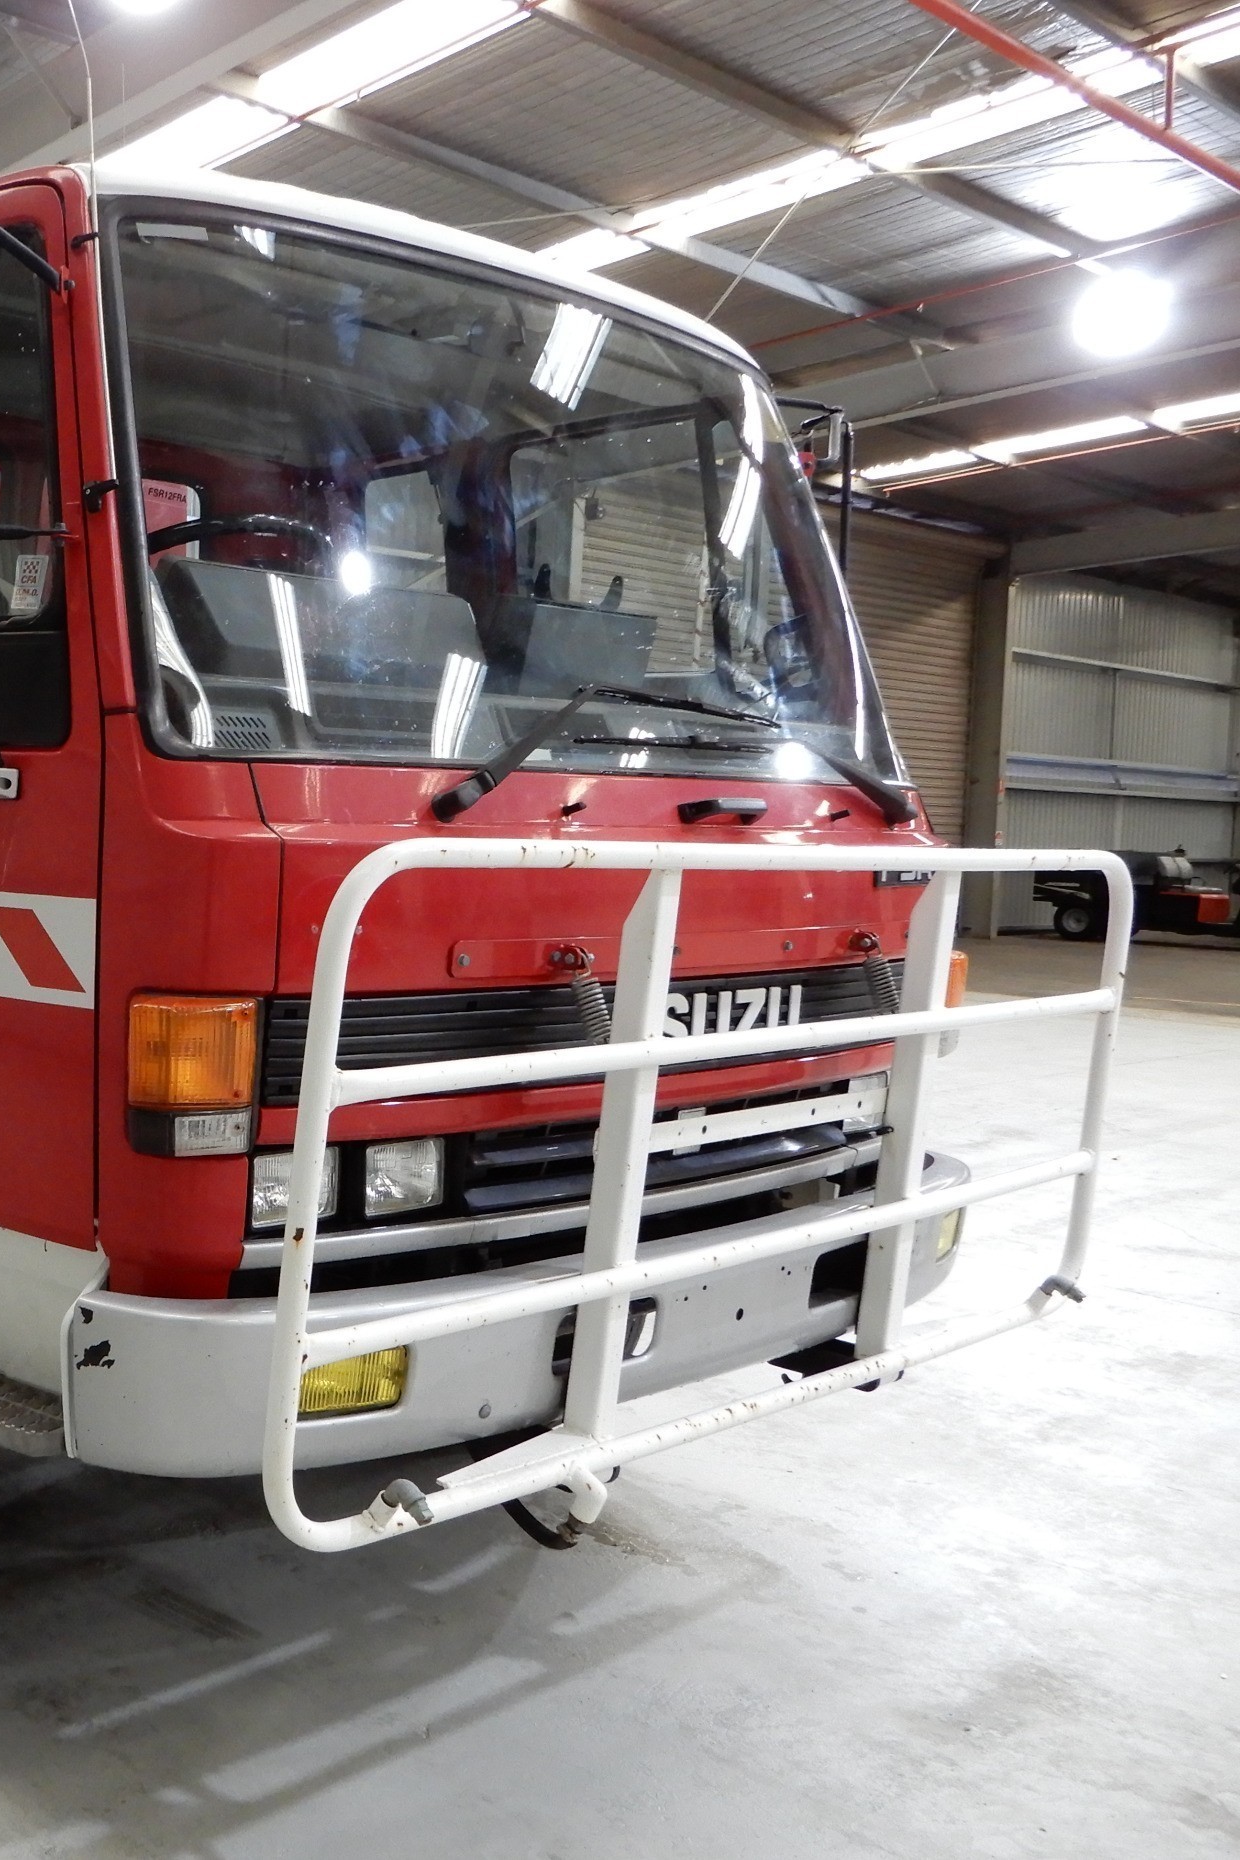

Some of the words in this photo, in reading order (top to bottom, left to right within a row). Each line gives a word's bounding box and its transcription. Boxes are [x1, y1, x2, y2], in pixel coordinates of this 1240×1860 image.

[148, 487, 187, 504] FSR12FRA
[20, 575, 38, 584] CFA
[662, 984, 803, 1038] SUZU
